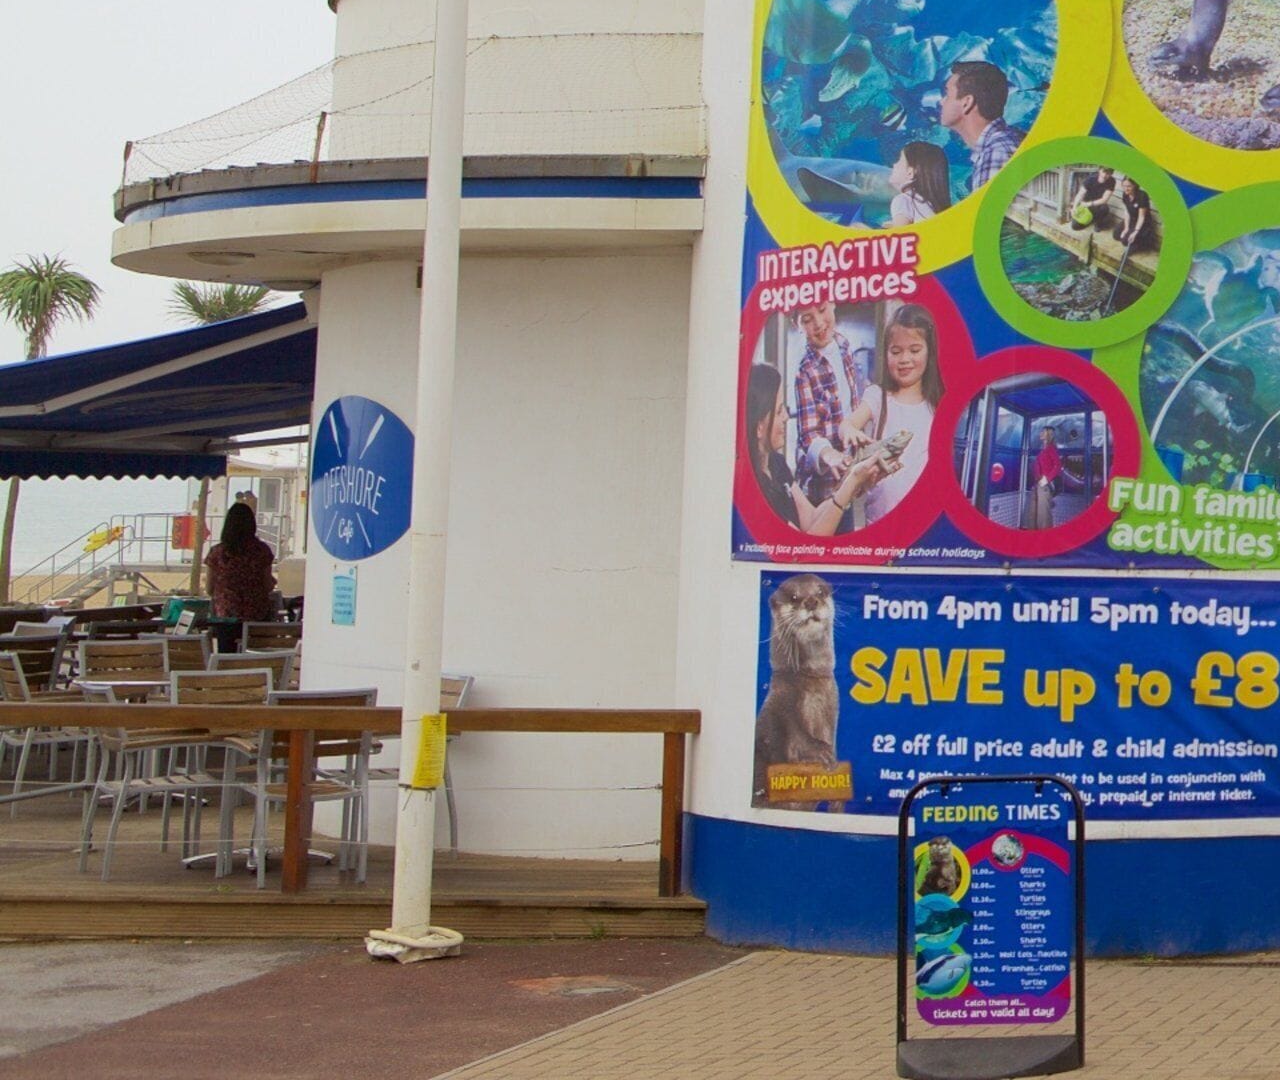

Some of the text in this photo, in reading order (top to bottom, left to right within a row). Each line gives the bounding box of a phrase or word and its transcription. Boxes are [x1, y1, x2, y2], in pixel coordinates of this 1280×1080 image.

[759, 235, 917, 282] INTERACTIVE
[759, 270, 917, 312] experiences
[323, 465, 387, 515] OFFSHORE
[1112, 480, 1181, 513] Fun
[793, 544, 825, 557] painting
[832, 544, 873, 556] available
[875, 545, 906, 558] during
[908, 546, 940, 558] school
[942, 547, 986, 559] holidays
[863, 594, 927, 621] From
[937, 595, 999, 629] 4pm
[1013, 597, 1079, 623] until
[1090, 597, 1158, 631] 5pm
[849, 647, 1006, 707] SAVE
[1023, 665, 1096, 723] up
[1116, 662, 1172, 708] to
[872, 734, 1279, 762] £2 off full price adult & child admission
[771, 774, 851, 791] HAPPY HOUR!
[880, 768, 904, 780] Max
[906, 768, 916, 781] 4
[1081, 773, 1095, 785] to
[1098, 771, 1114, 785] be
[1117, 771, 1147, 786] used
[1151, 770, 1164, 784] in
[1167, 770, 1237, 787] conjunction
[1240, 769, 1266, 784] with
[1100, 789, 1147, 804] prepaid
[1150, 792, 1165, 803] or
[1168, 788, 1216, 803] internet
[922, 803, 1061, 823] FEEDING TIMES
[933, 1007, 1055, 1019] tickets are valid all day!
